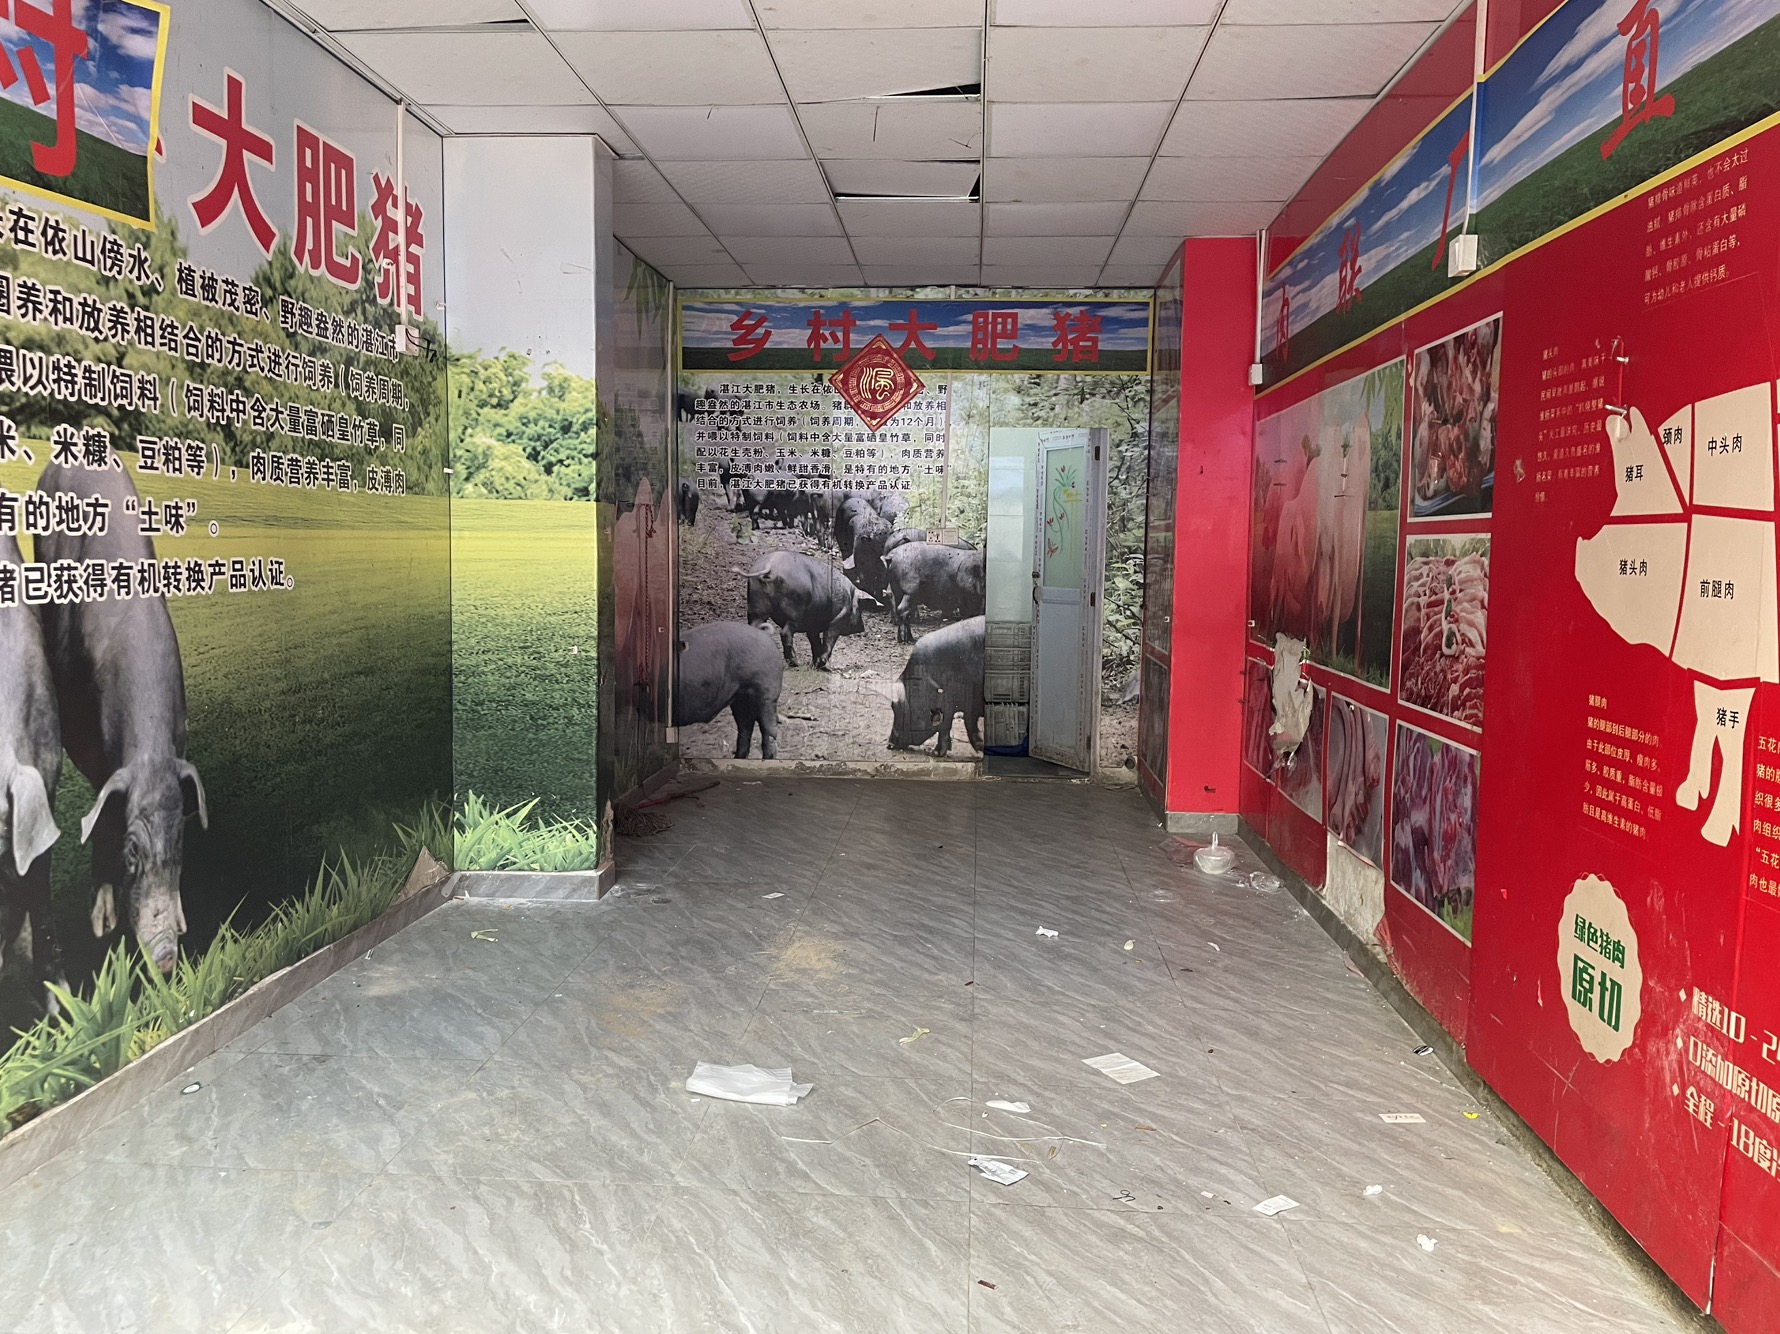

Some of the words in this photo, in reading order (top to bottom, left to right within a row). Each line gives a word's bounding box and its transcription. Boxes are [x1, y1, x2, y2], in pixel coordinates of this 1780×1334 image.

[190, 72, 423, 317] 大肥猪
[0, 207, 398, 361] 在依山傍水、植被茂密、野趣盎然的湛江市
[727, 309, 1103, 363] 乡村大肥猪
[1662, 425, 1683, 446] 颈肉
[1707, 432, 1743, 457] 中头肉
[1625, 464, 1644, 483] 猪耳
[1619, 558, 1648, 577] 猪头肉
[1699, 579, 1735, 600] 前腿肉
[1716, 706, 1740, 729] 猪手
[1574, 913, 1626, 970] 绿色猪肉
[1571, 952, 1623, 1033] 原切
